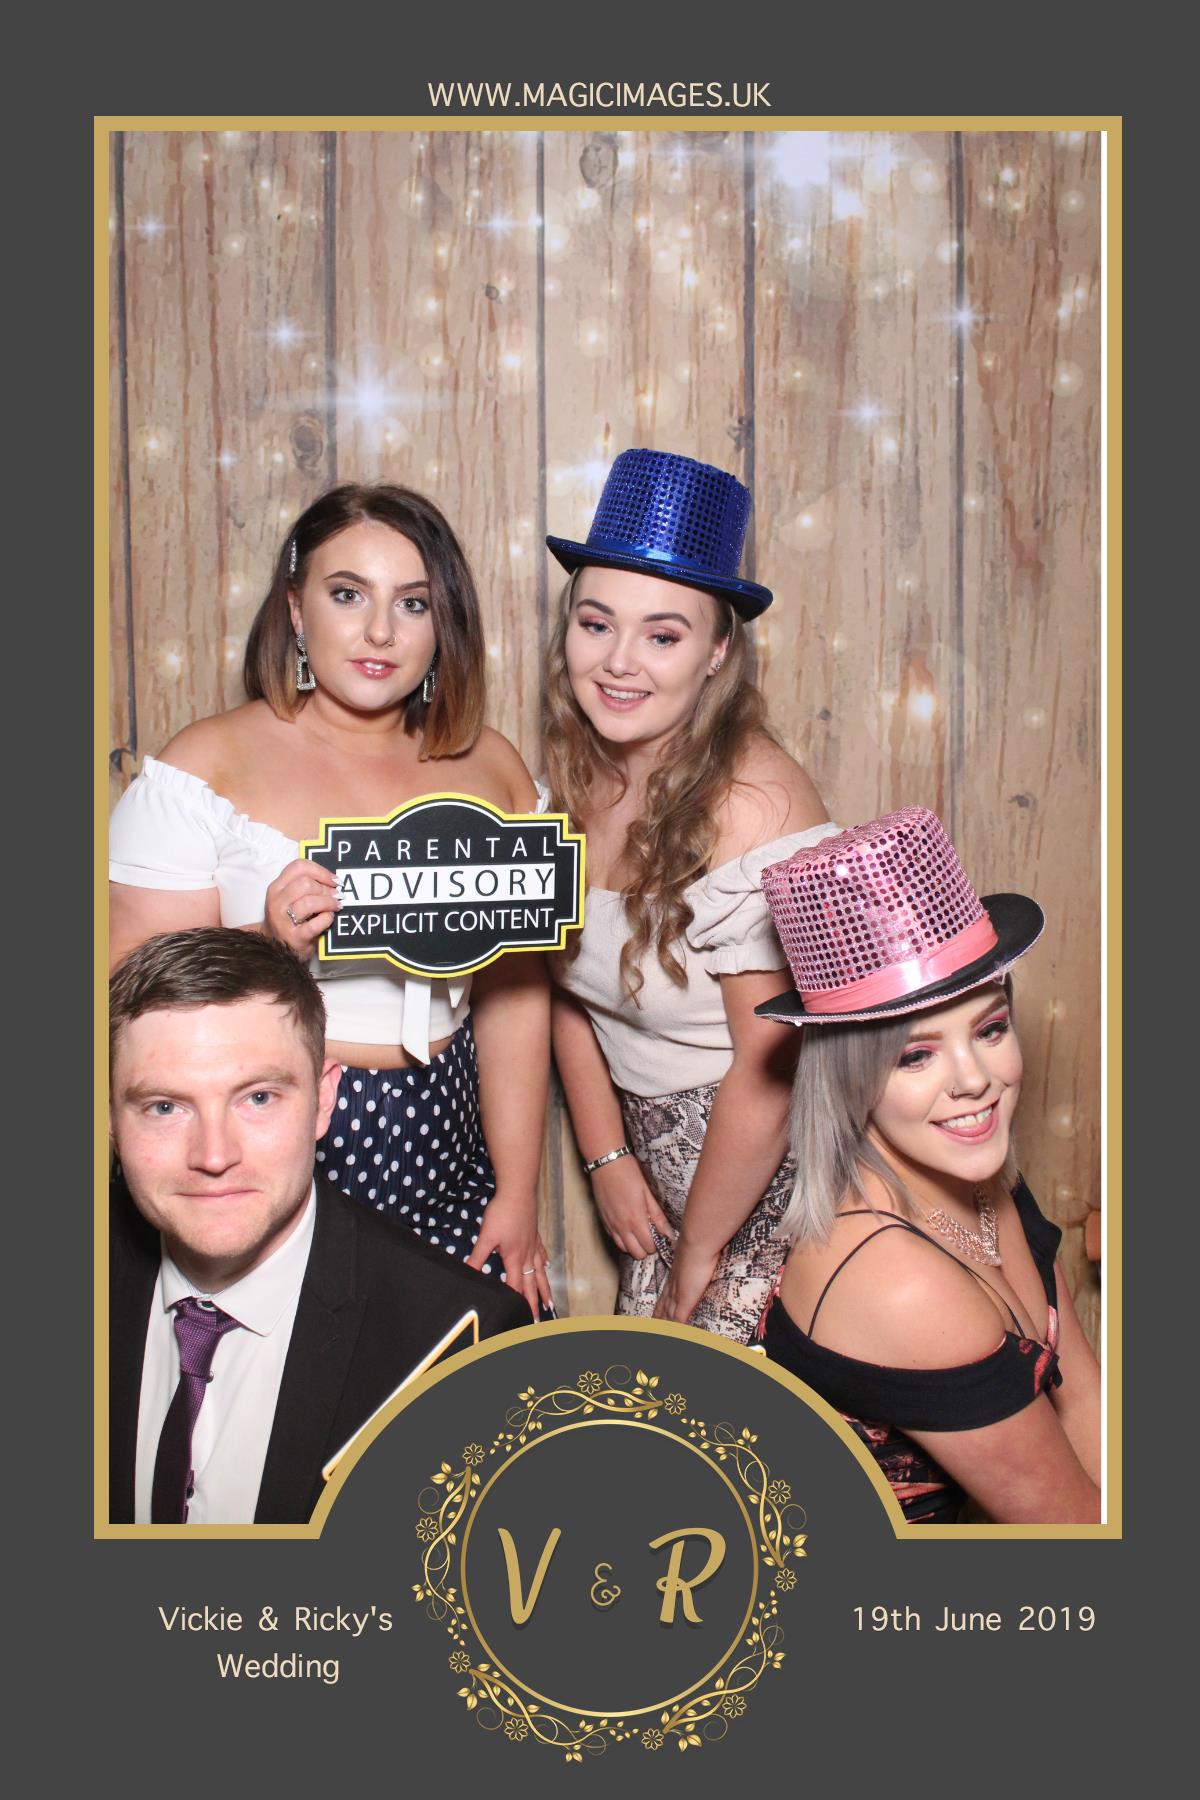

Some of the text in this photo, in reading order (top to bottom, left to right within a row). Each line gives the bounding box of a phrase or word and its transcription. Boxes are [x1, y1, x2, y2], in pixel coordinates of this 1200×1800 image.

[336, 836, 555, 862] PARENTAL
[340, 867, 554, 901] ADVISORY
[336, 907, 555, 937] EXPLICIT CONTENT
